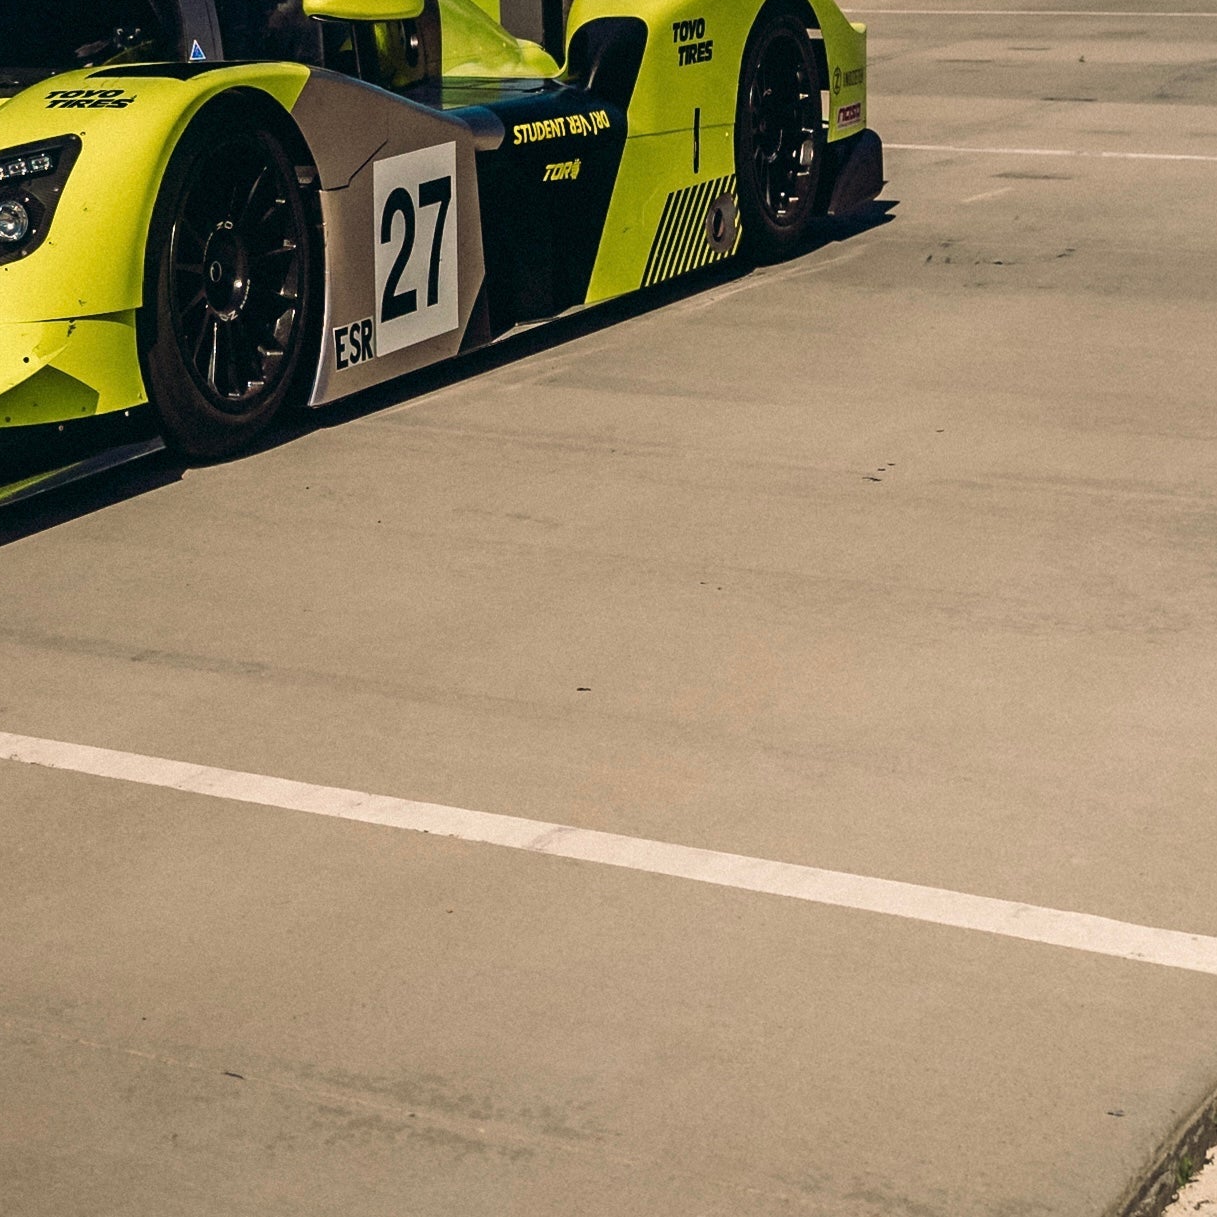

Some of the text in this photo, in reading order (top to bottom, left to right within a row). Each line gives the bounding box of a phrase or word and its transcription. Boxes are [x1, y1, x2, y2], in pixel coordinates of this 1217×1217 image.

[673, 17, 706, 43] TOYO
[678, 40, 714, 66] TIRES
[45, 90, 125, 99] TOYO
[46, 99, 135, 108] TIRES
[513, 117, 566, 145] STUDENT
[381, 176, 452, 323] 27
[335, 319, 374, 370] ESR
